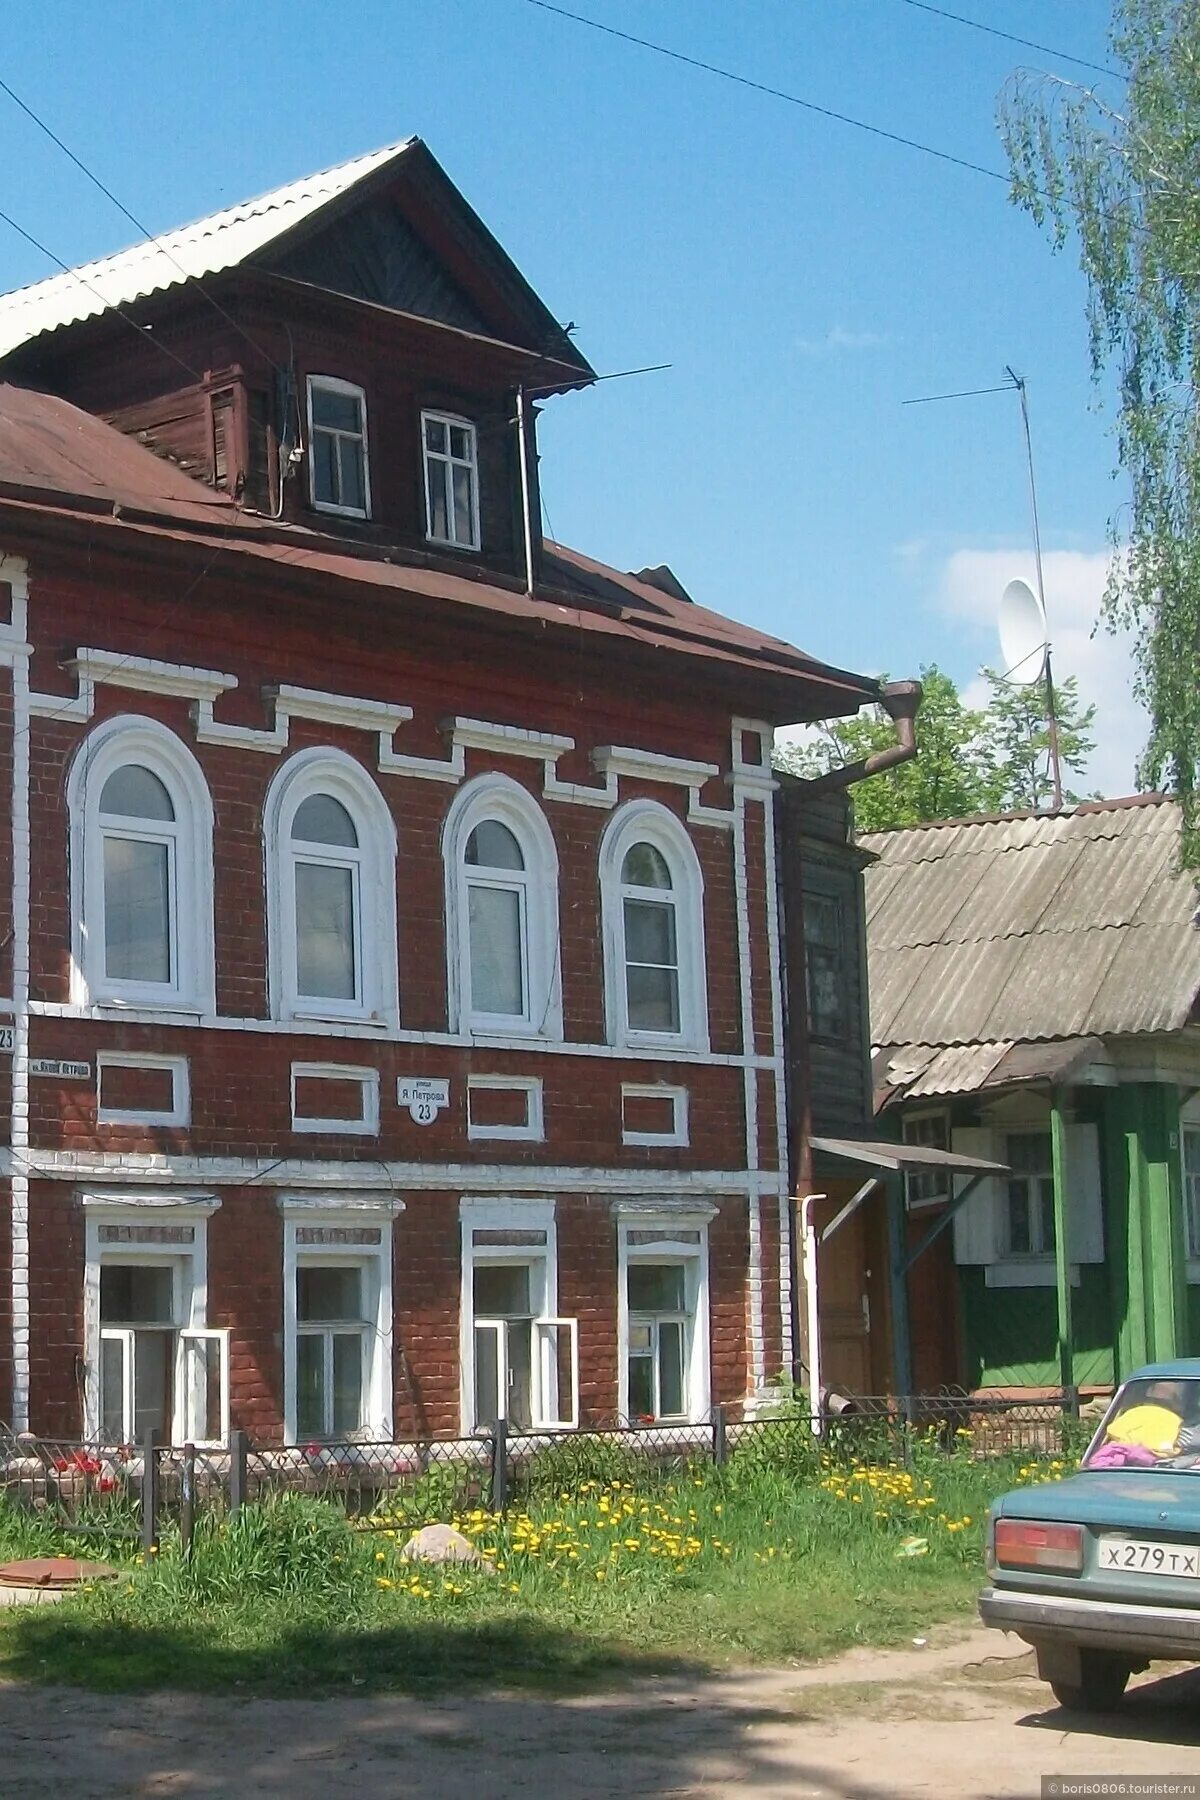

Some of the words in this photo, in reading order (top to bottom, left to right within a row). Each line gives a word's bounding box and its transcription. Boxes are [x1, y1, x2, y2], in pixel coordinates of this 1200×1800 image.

[0, 1029, 12, 1047] 23
[412, 1090, 444, 1101] Петрова
[419, 1104, 430, 1119] 23
[1108, 1545, 1195, 1572] Х279ТХ
